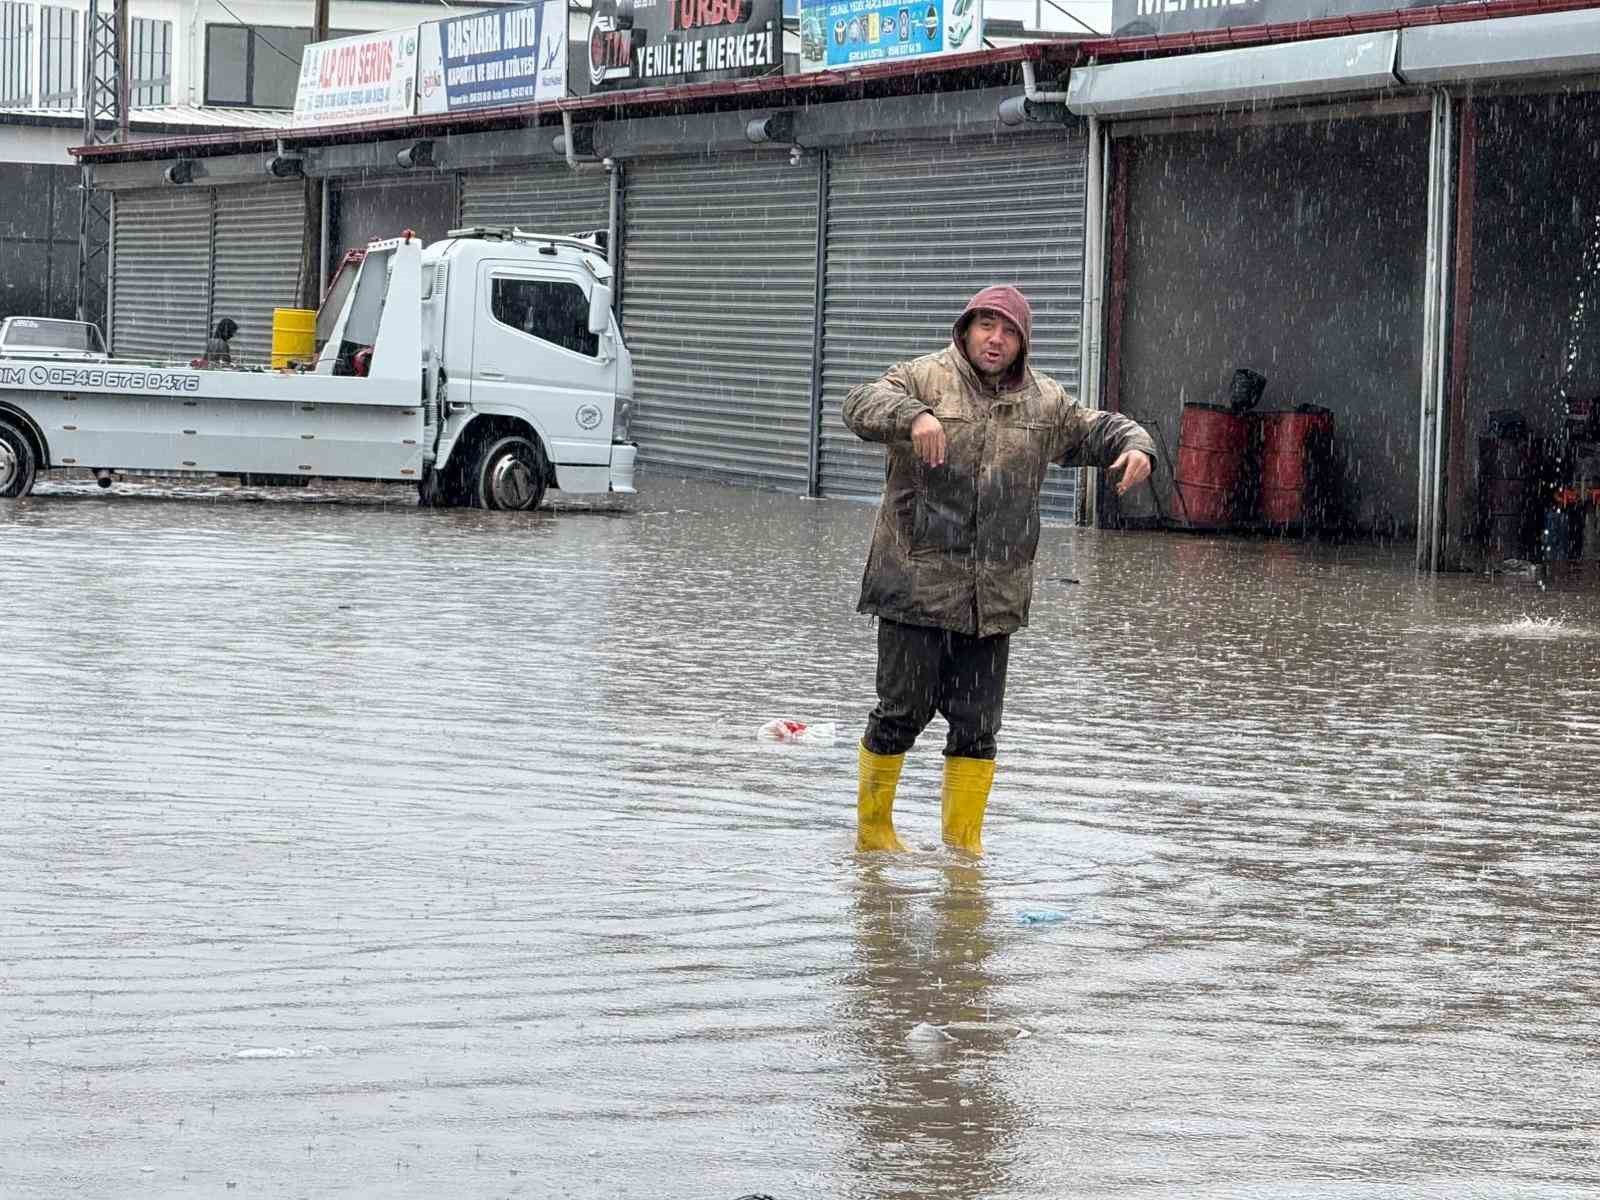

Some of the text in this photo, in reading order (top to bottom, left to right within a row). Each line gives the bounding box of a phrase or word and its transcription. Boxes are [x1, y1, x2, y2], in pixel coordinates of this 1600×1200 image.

[448, 8, 535, 63] BAŞKARA AUTO
[636, 21, 773, 78] YENİLEME MERKEZİ
[337, 44, 356, 87] OTO
[50, 368, 102, 387] 0546
[104, 370, 145, 389] 676
[146, 374, 200, 391] 0476
